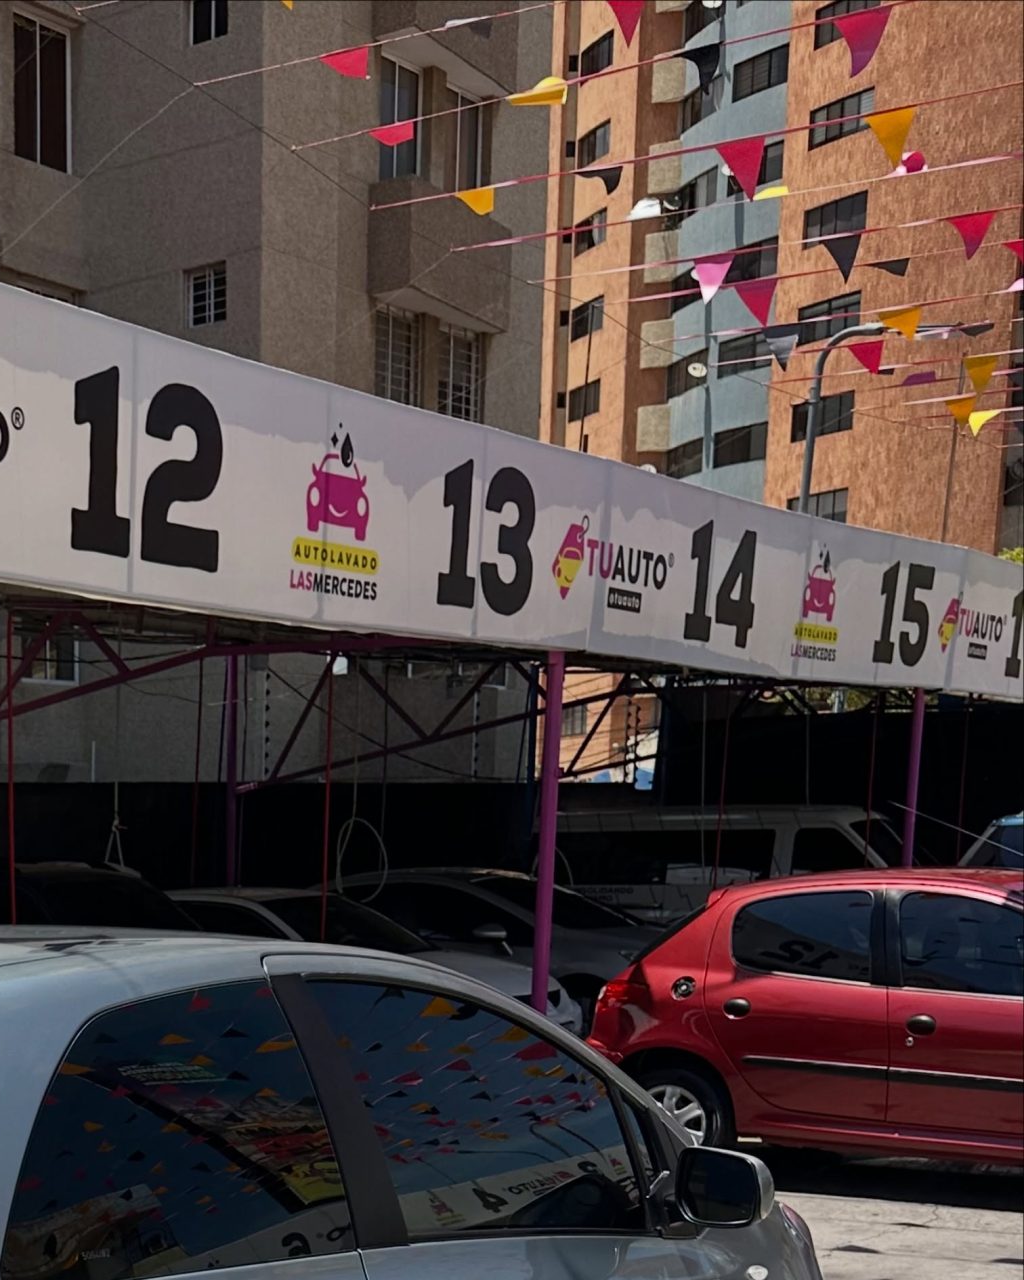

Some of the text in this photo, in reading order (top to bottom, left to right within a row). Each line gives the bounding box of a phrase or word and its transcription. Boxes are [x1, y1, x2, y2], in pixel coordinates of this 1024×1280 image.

[71, 366, 224, 573] 12
[294, 544, 377, 571] AUTOLAVADO
[437, 459, 536, 616] 13
[683, 519, 757, 649] 14
[872, 560, 936, 667] 15
